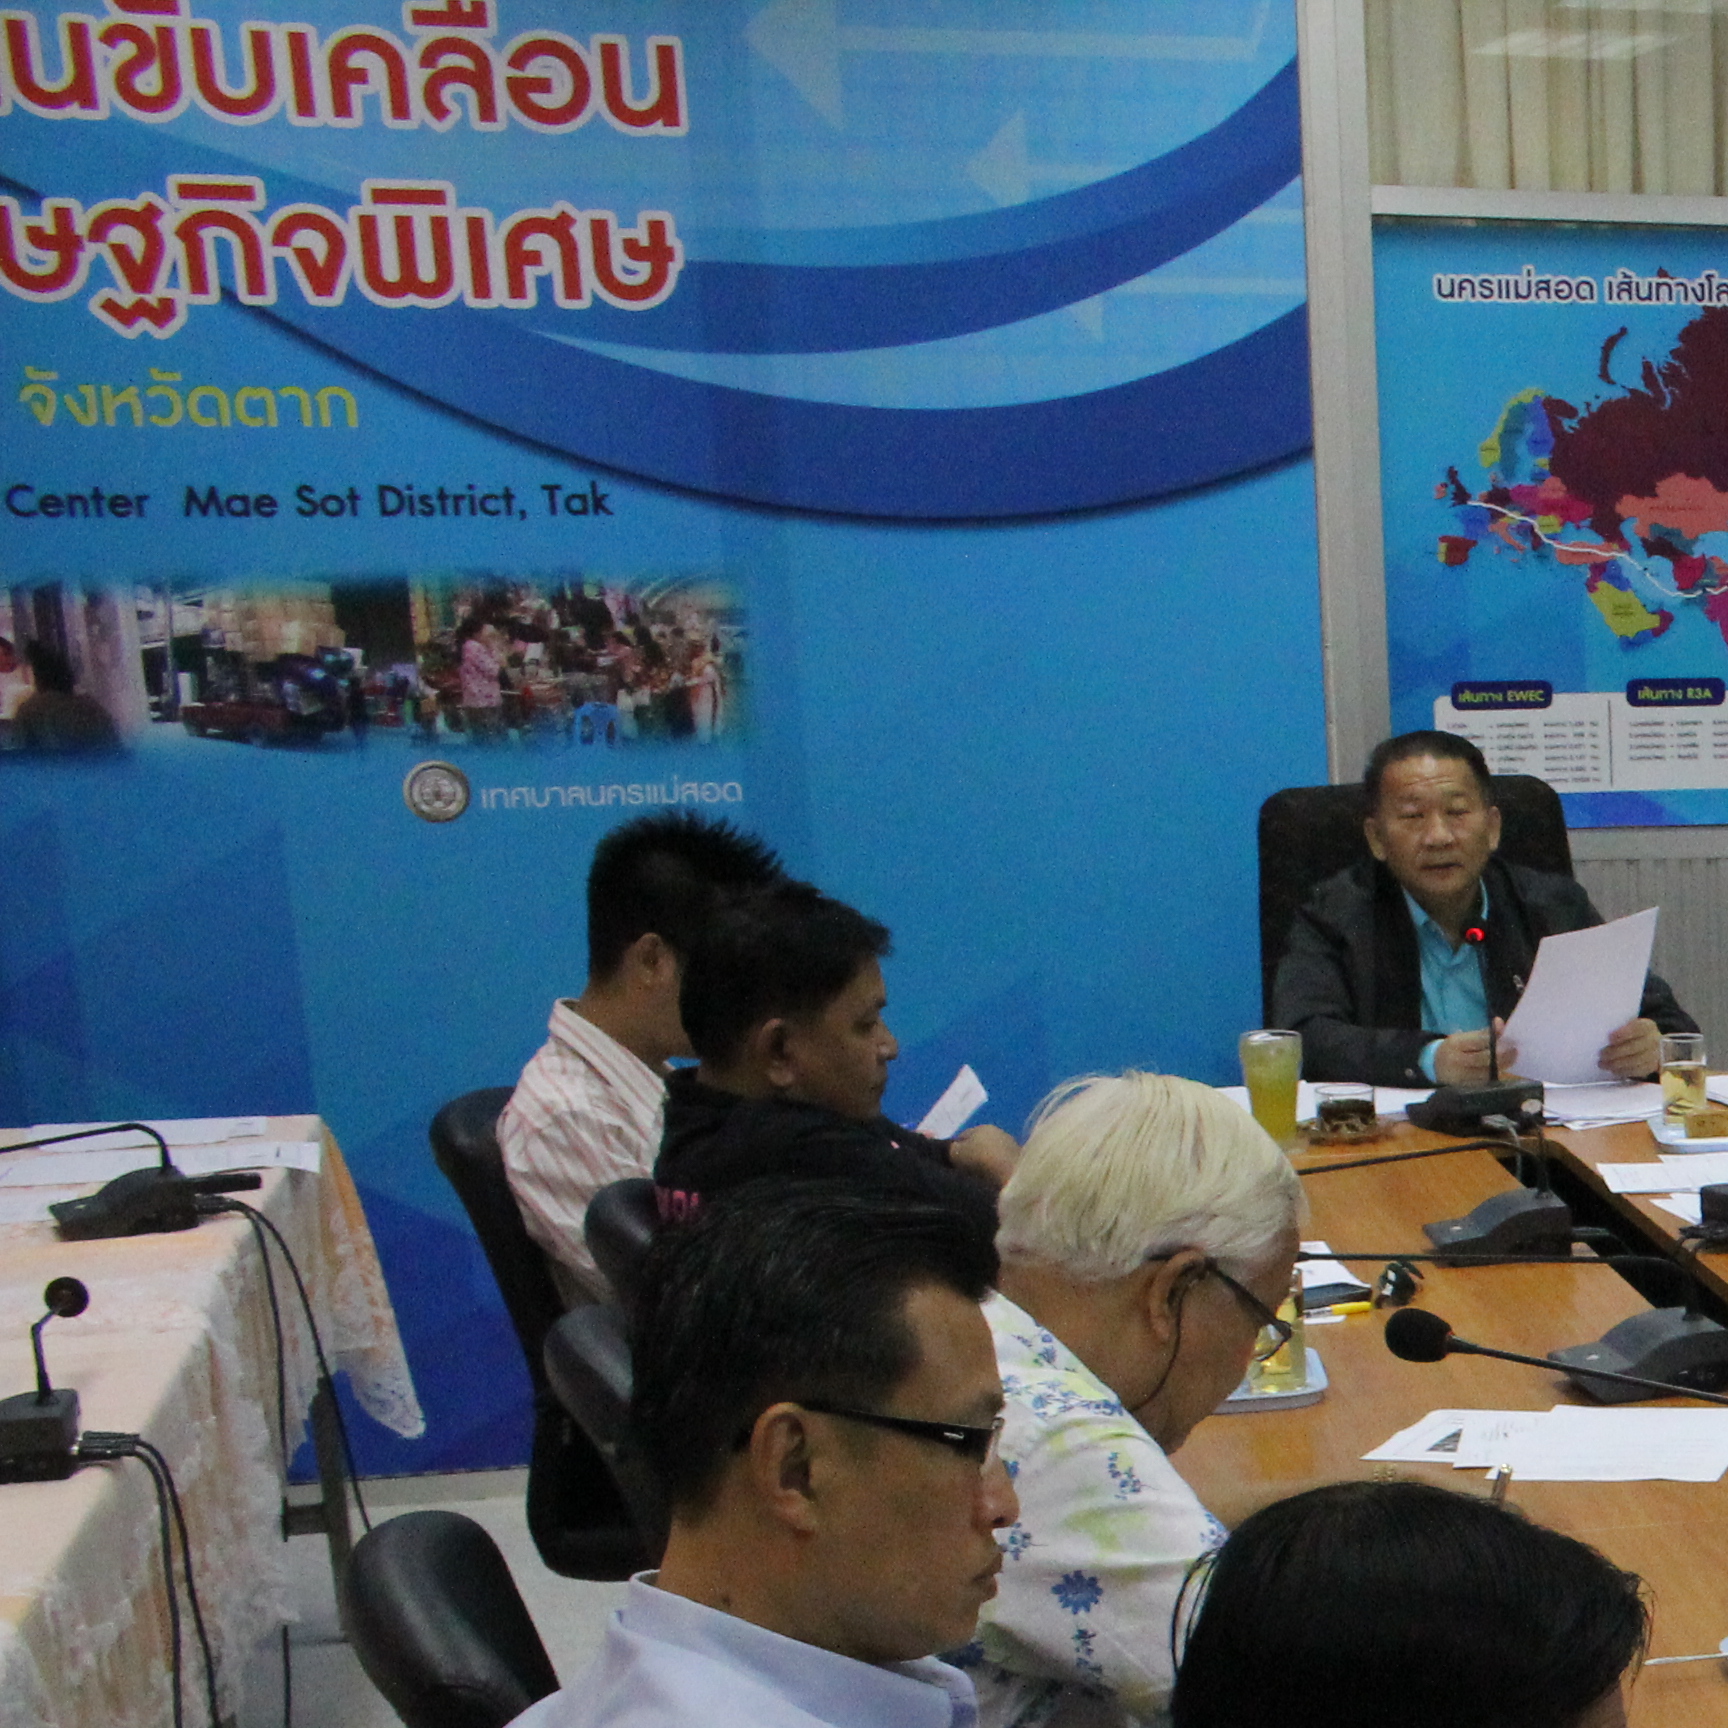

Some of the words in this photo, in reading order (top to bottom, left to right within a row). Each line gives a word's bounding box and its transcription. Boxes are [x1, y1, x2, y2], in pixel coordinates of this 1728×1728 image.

[2, 0, 684, 131] นขบเคลือน
[0, 179, 679, 334] ษฐกิจพิเศษ
[1434, 266, 1596, 304] นครแม่สอด
[19, 366, 360, 429] จังหวัดตาก
[5, 484, 149, 519] Center
[184, 485, 279, 519] Mae
[295, 485, 361, 519] Sot
[379, 483, 528, 522] District,
[541, 483, 614, 518] Tak
[1507, 690, 1545, 702] EWEC
[480, 773, 745, 810] เทศบาลนครแม่สอด
